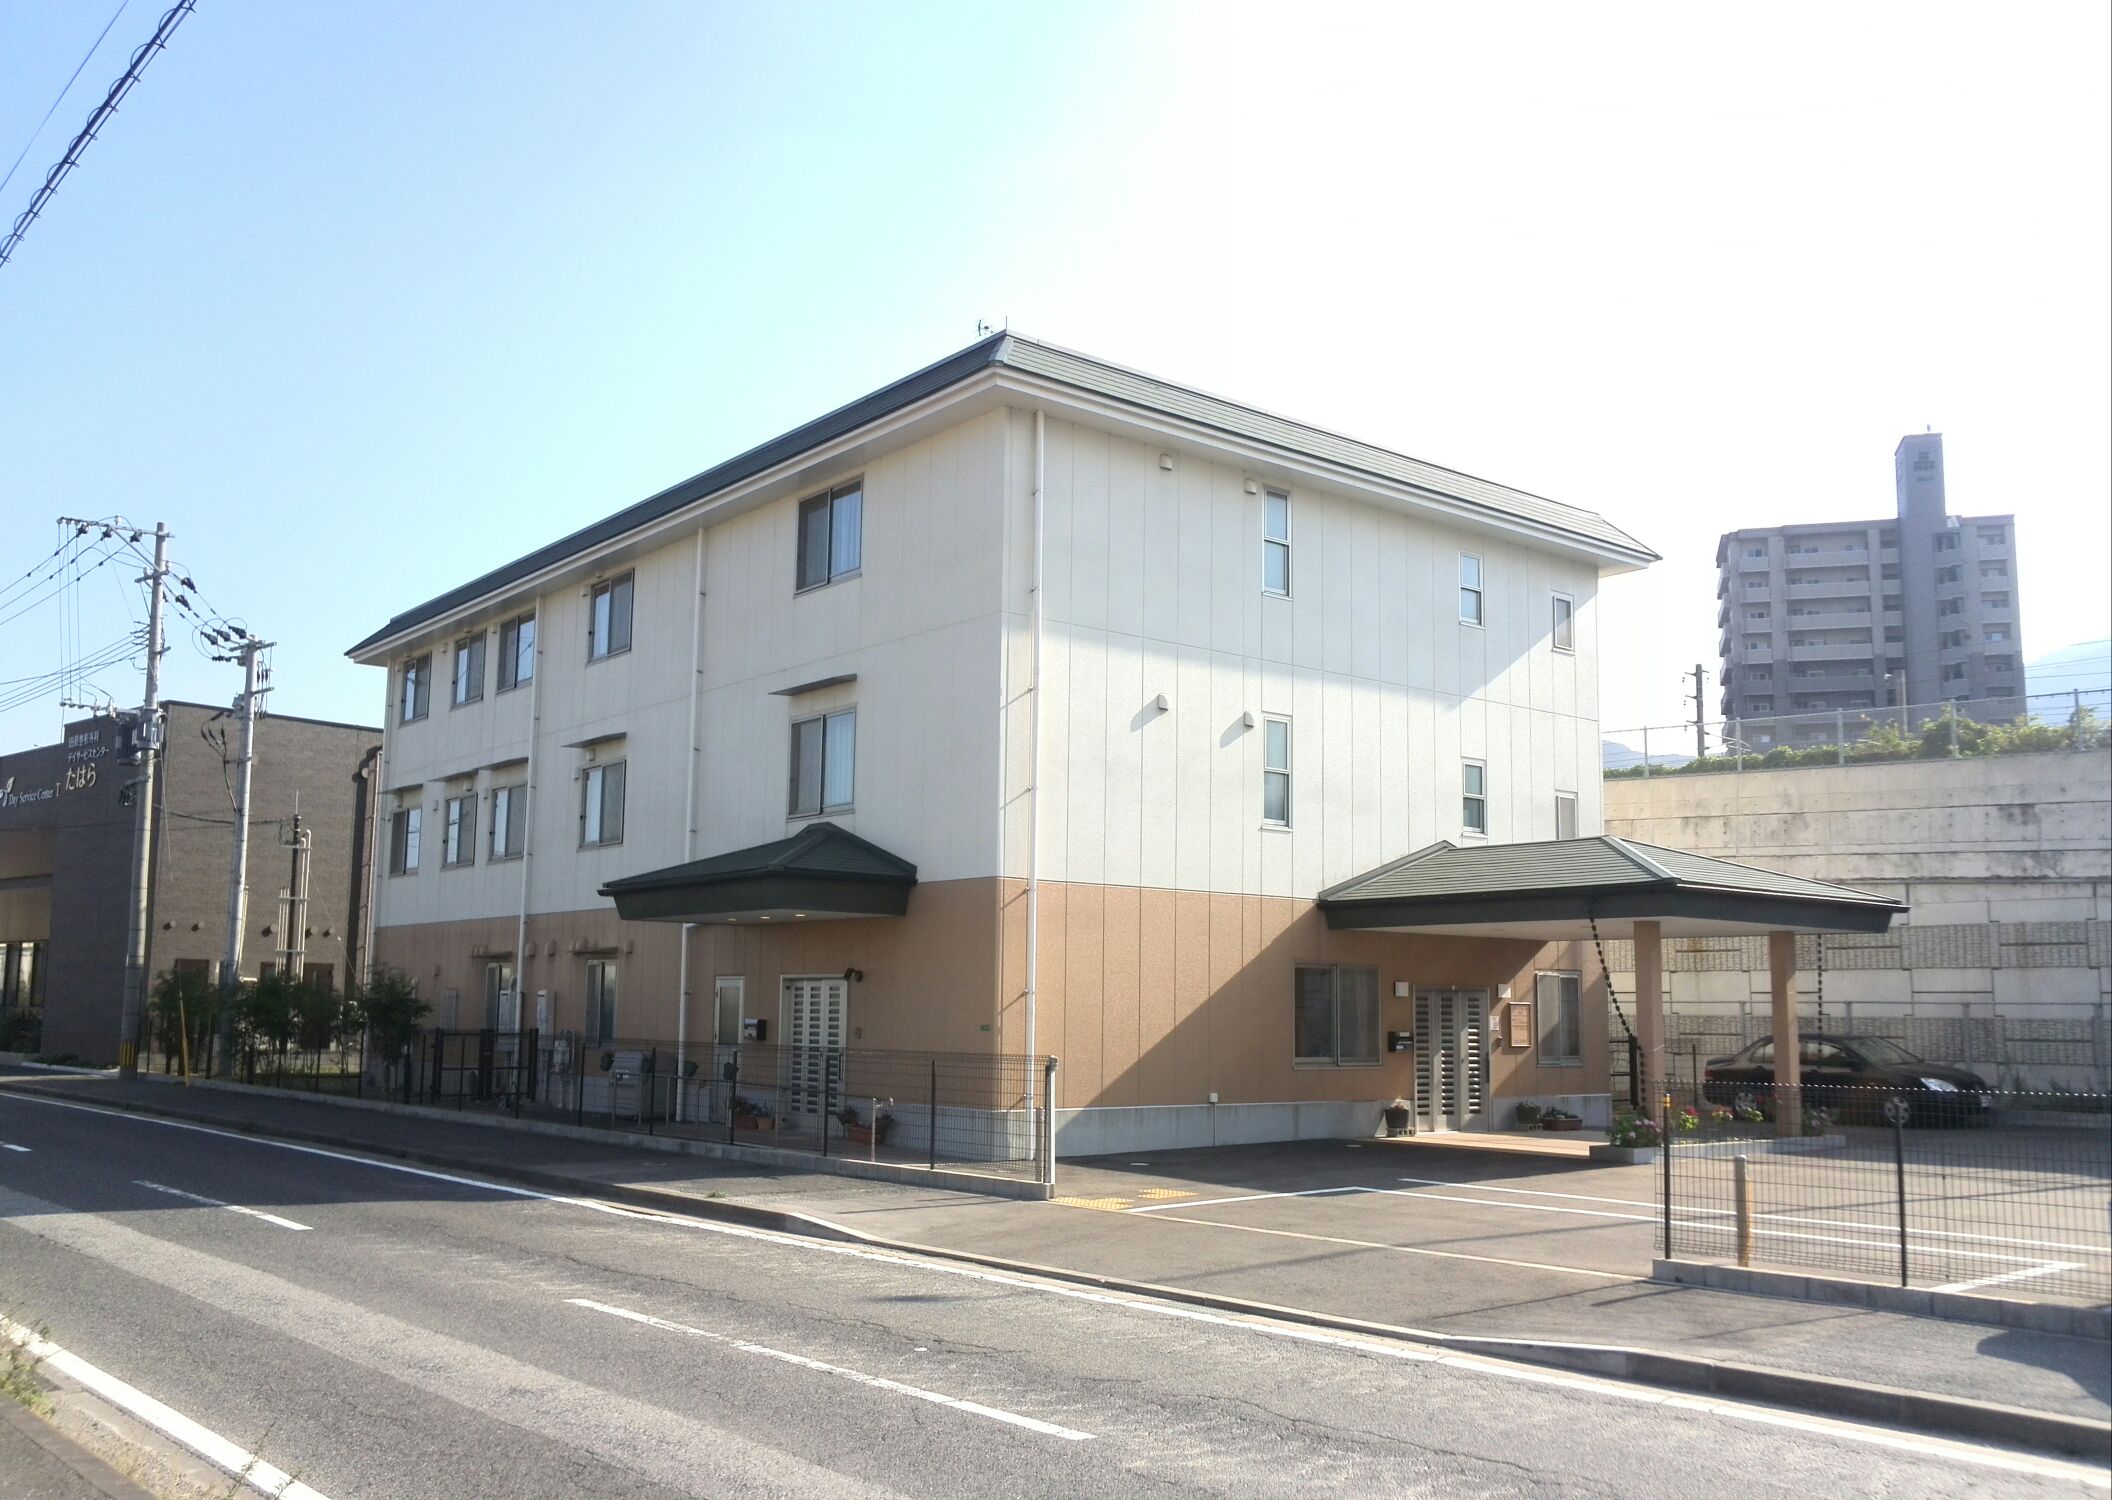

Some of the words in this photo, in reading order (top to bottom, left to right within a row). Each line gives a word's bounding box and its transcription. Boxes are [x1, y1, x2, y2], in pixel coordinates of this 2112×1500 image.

[67, 746, 110, 763] デイサービスセンター
[65, 763, 96, 791] たはら
[8, 794, 19, 807] Day
[19, 790, 37, 803] Service
[37, 788, 54, 801] Center
